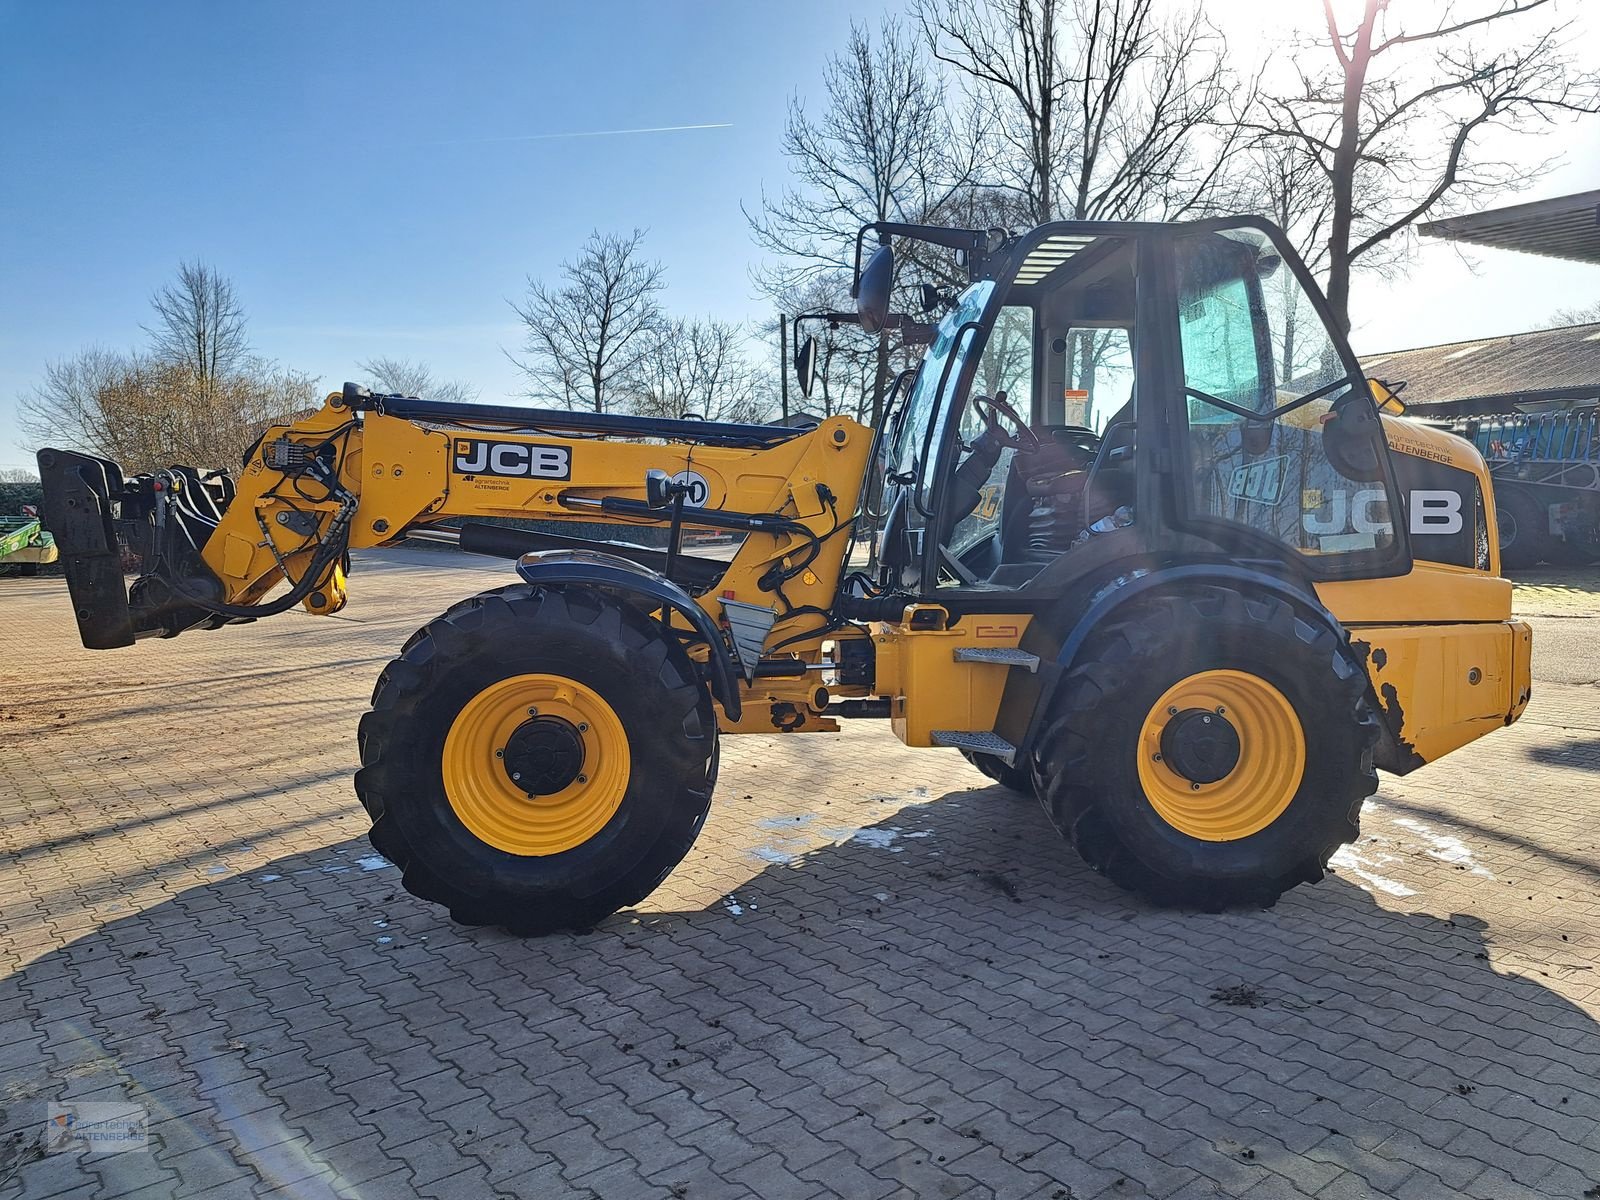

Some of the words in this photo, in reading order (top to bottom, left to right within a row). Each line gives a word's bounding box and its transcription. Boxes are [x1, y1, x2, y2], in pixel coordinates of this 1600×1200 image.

[456, 442, 569, 478] JCB
[1389, 441, 1453, 464] ALTENBERGE
[1302, 489, 1463, 535] JCB
